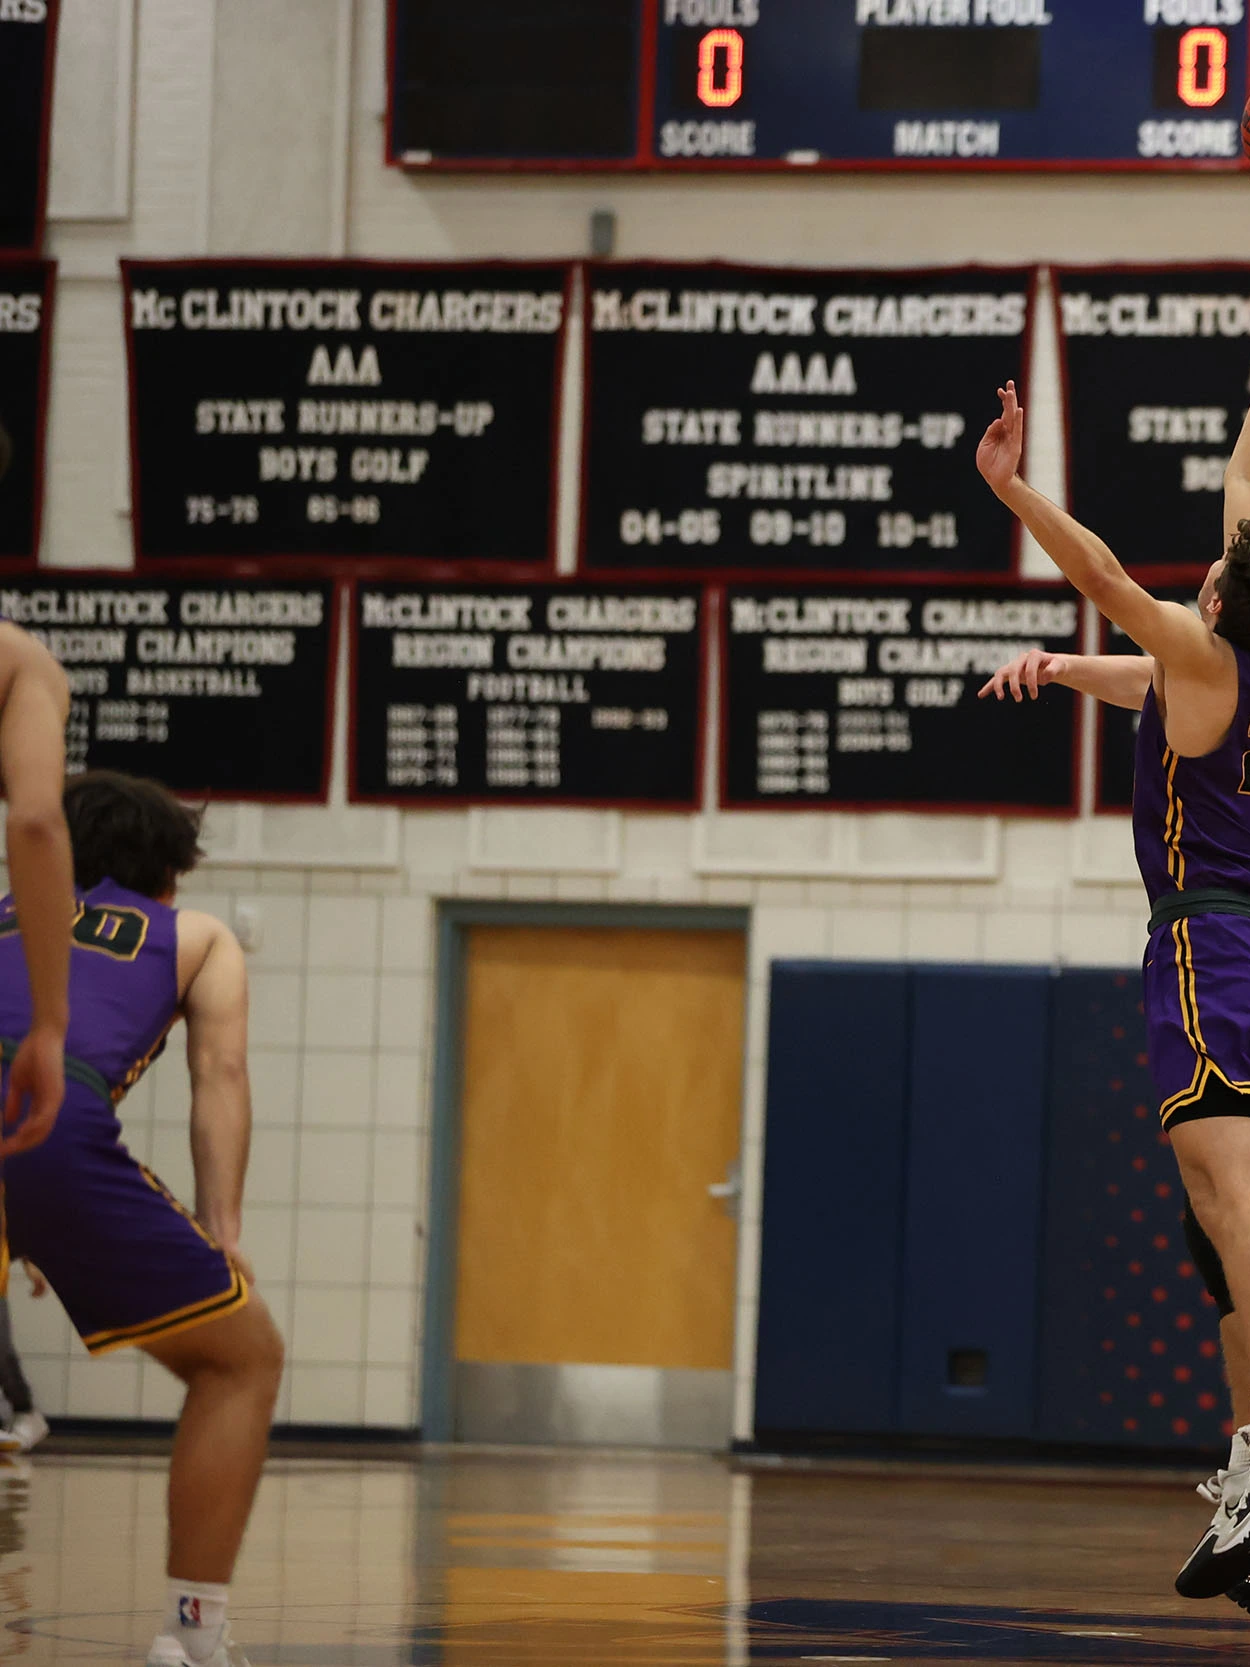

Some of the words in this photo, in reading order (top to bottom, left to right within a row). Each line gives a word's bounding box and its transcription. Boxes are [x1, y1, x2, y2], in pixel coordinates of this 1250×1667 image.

[697, 28, 744, 107] 0
[1178, 27, 1228, 107] 0
[661, 121, 755, 157] SCORE
[894, 120, 1000, 157] MATCH
[1138, 120, 1237, 157] SCORE
[369, 291, 564, 333] CHARGERS
[823, 293, 1027, 336] CHARGERS
[307, 346, 381, 386] AAA
[751, 353, 856, 395] AAAA
[196, 400, 285, 434] STATE
[298, 400, 494, 436] RUNNERS-UP
[643, 409, 741, 446] STATE
[754, 411, 965, 448] RUNNERS-UP
[1129, 407, 1227, 443] STATE
[259, 447, 337, 482] BOYS
[351, 448, 429, 484] GOLF
[707, 463, 892, 501] SPIRITLINE
[180, 592, 323, 626] CHARGERS
[547, 597, 696, 632] CHARGERS
[922, 600, 1077, 637] CHARGERS
[137, 630, 295, 665] CHAMPIONS
[507, 635, 666, 671] CHAMPIONS
[126, 668, 261, 697] BASKETBALL
[467, 673, 589, 703] FOOTBALL
